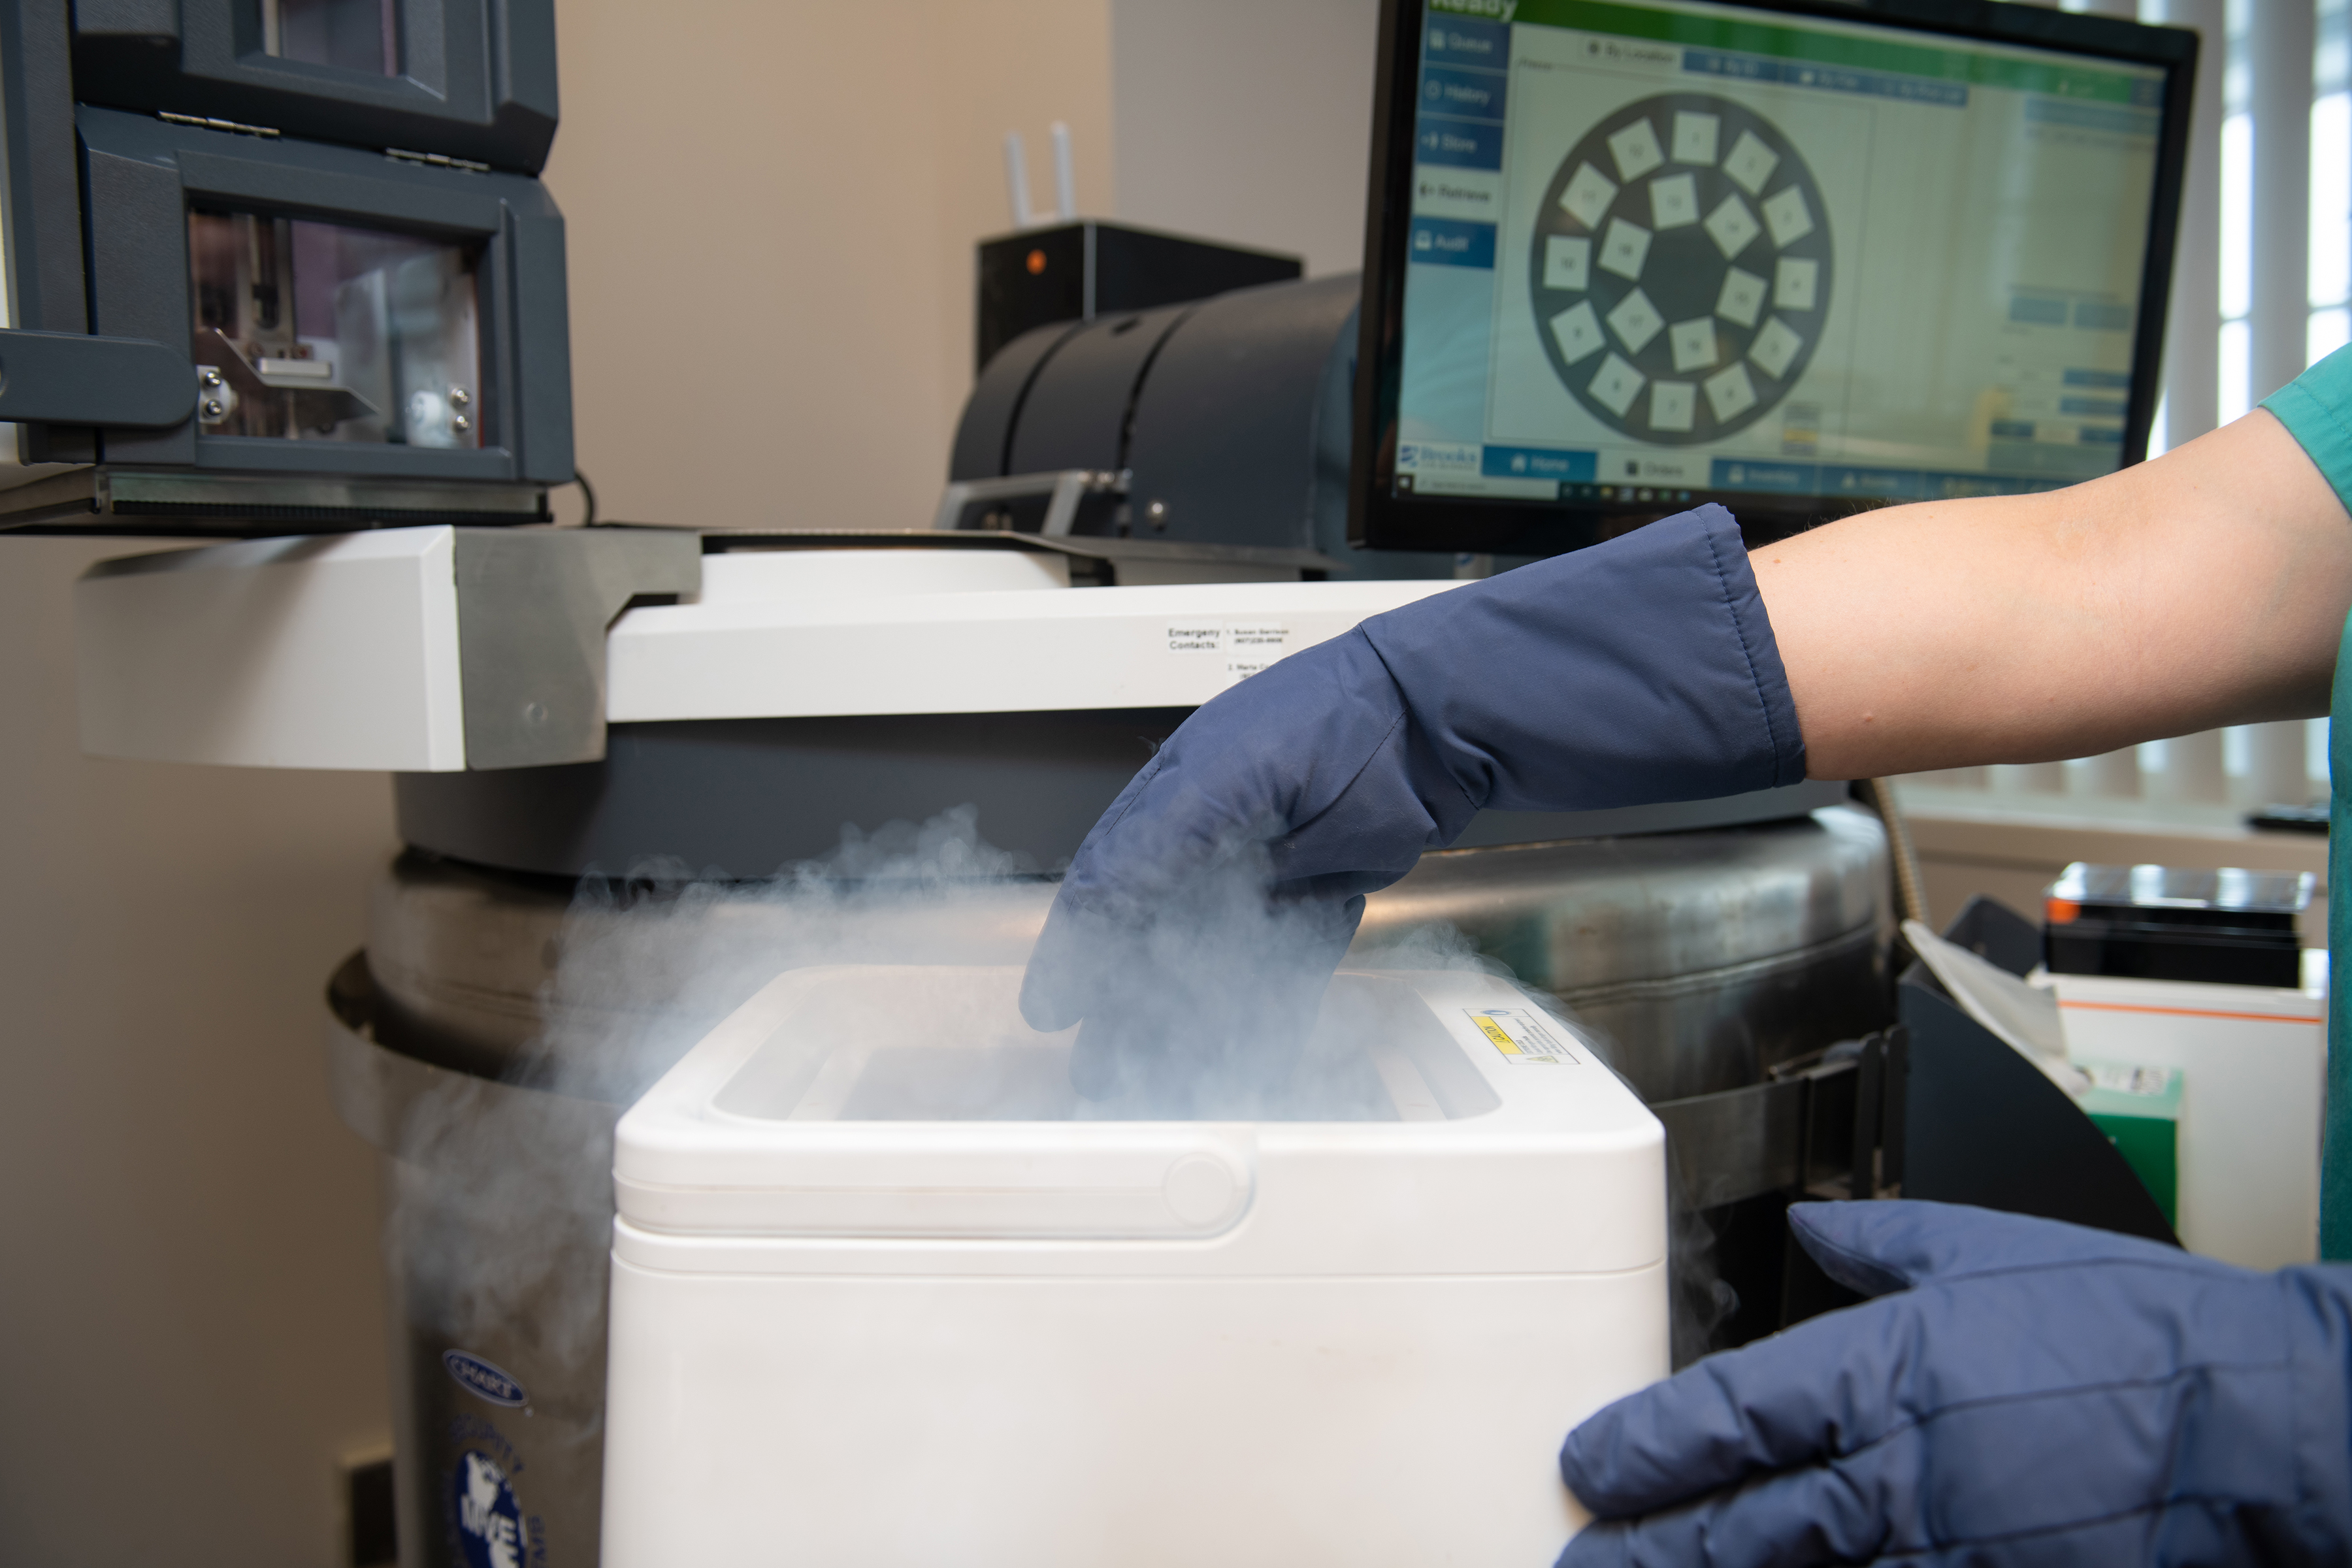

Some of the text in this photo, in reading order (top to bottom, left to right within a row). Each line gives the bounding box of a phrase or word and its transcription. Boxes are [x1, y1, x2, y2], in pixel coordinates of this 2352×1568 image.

[1444, 79, 1491, 106] History
[1441, 134, 1477, 153] Store
[1438, 182, 1490, 201] Retrieve
[1435, 234, 1468, 252] Audit
[1530, 455, 1569, 471] Home
[1482, 1026, 1505, 1039] CAUTION
[449, 1357, 512, 1399] CHART
